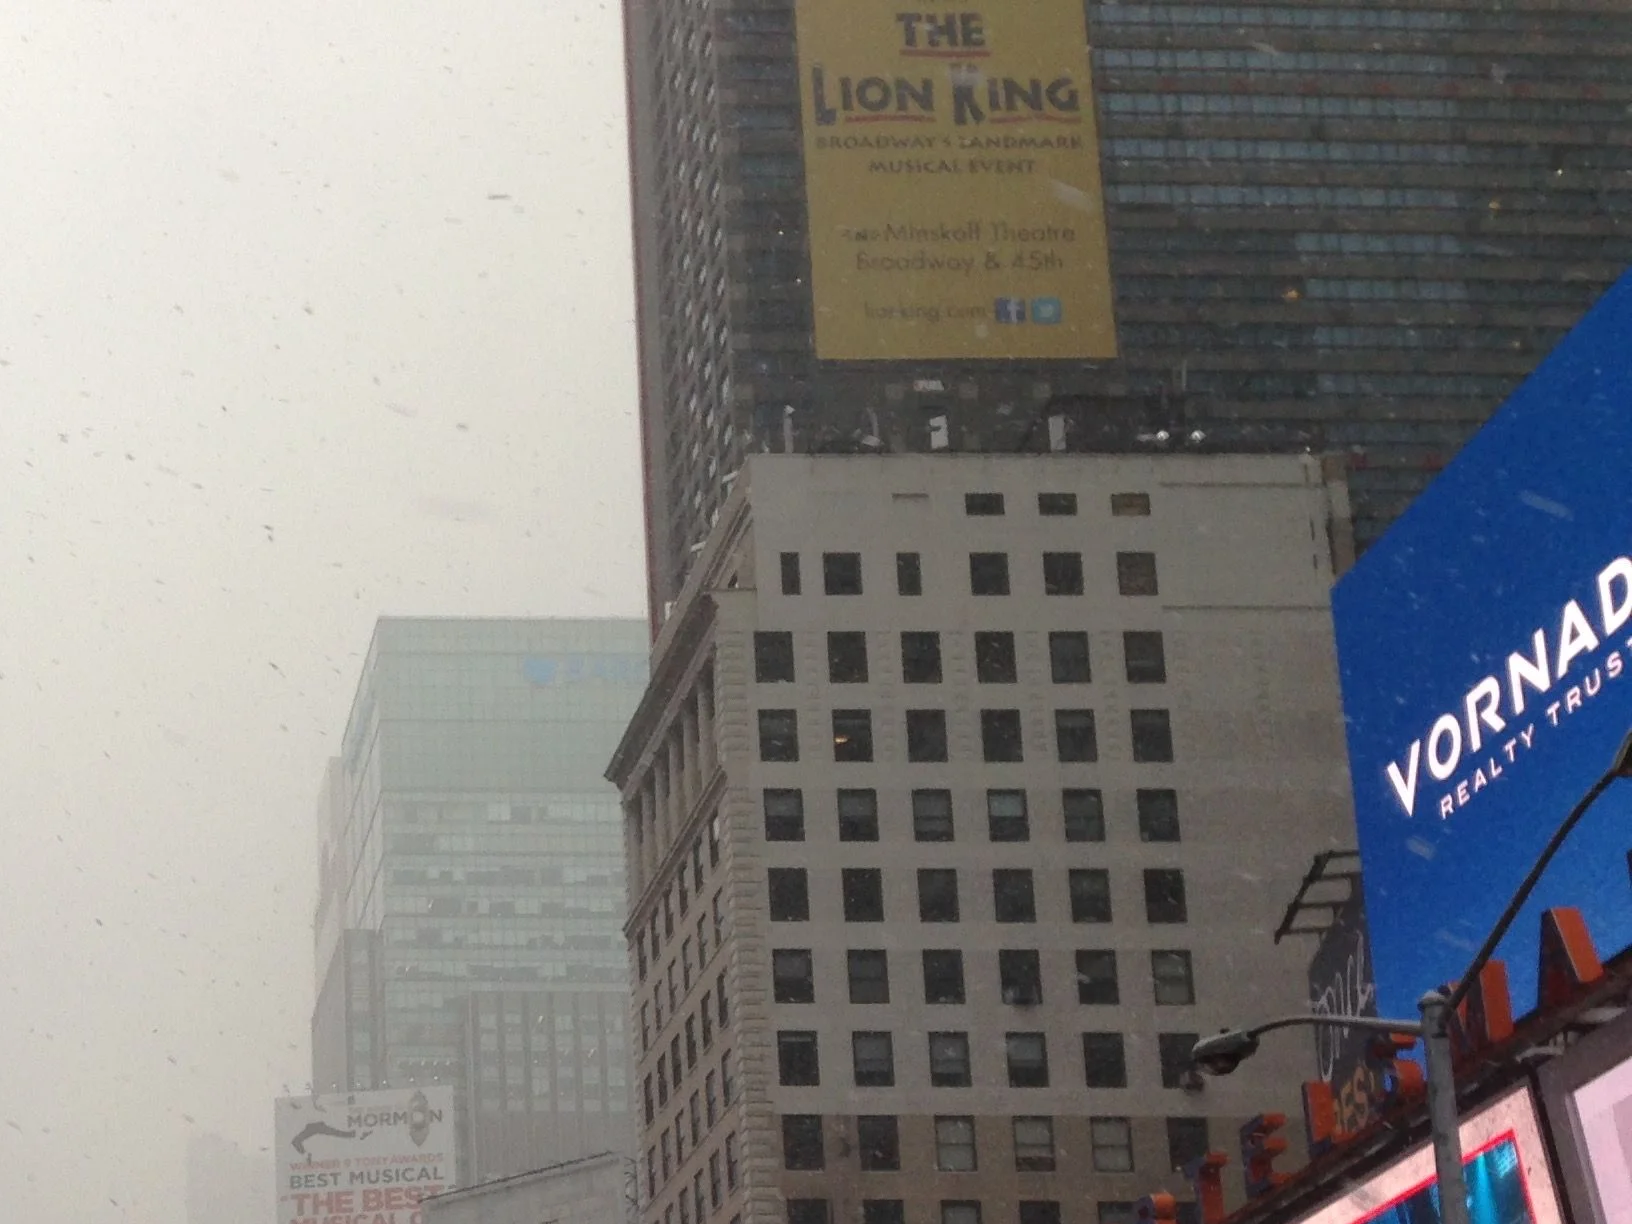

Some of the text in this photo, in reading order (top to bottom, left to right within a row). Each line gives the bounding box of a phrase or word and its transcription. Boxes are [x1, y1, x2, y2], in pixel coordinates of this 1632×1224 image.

[896, 12, 986, 48] THE
[812, 62, 1081, 126] LION KING
[959, 134, 1083, 150] LANDMARK
[869, 158, 1037, 174] MUSICAL EVENT
[993, 220, 1076, 241] Theatre
[856, 251, 974, 273] Broadway
[984, 252, 1001, 270] &
[1439, 723, 1536, 820] REALTY
[347, 1109, 444, 1130] MORMON
[355, 1156, 389, 1169] TONY
[389, 1152, 444, 1165] AWARDS
[290, 1165, 445, 1190] BEST MUSICAL
